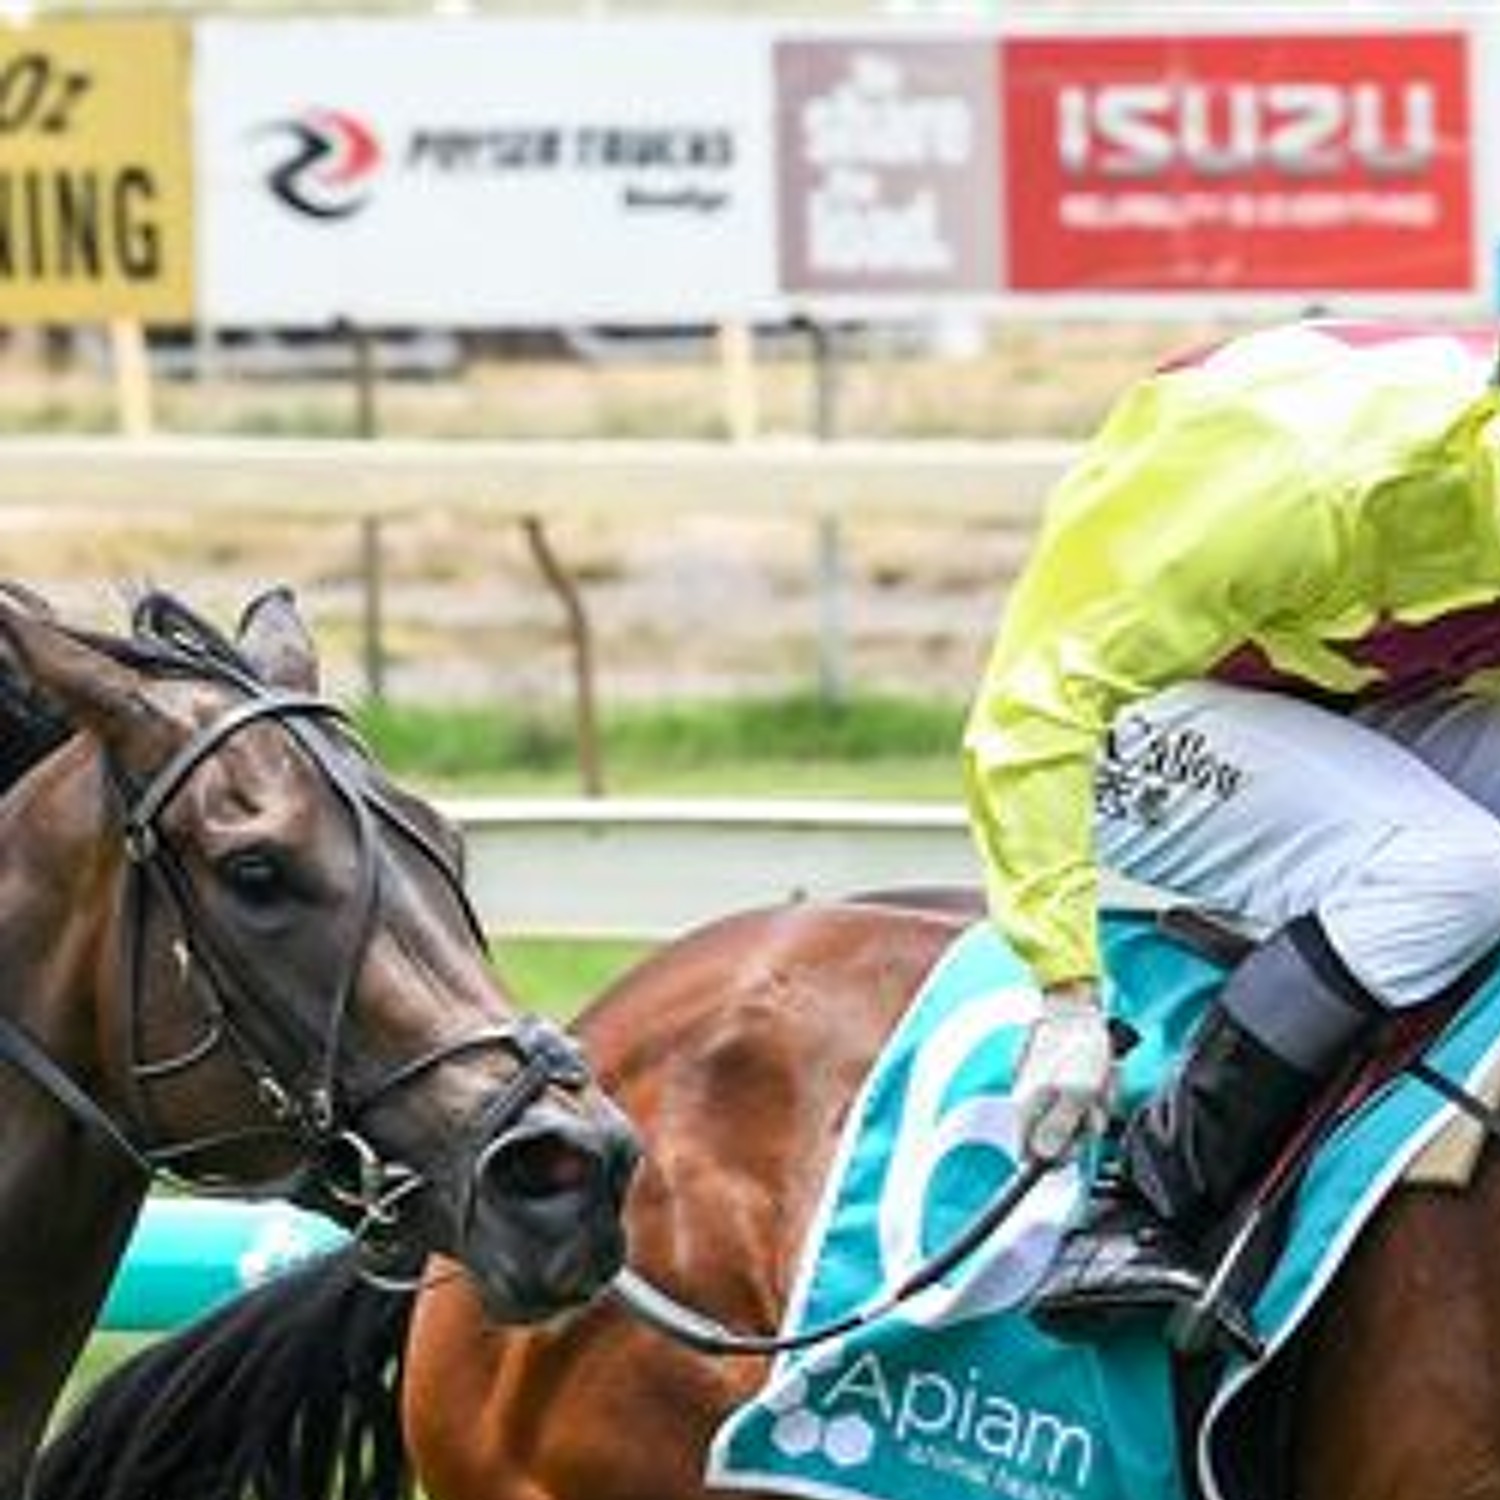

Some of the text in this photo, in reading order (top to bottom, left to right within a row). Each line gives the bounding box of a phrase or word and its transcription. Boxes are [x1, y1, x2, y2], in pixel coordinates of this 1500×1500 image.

[577, 129, 734, 168] TRUCKS
[1058, 83, 1436, 178] ISUZU
[820, 1350, 1093, 1487] Apiam
